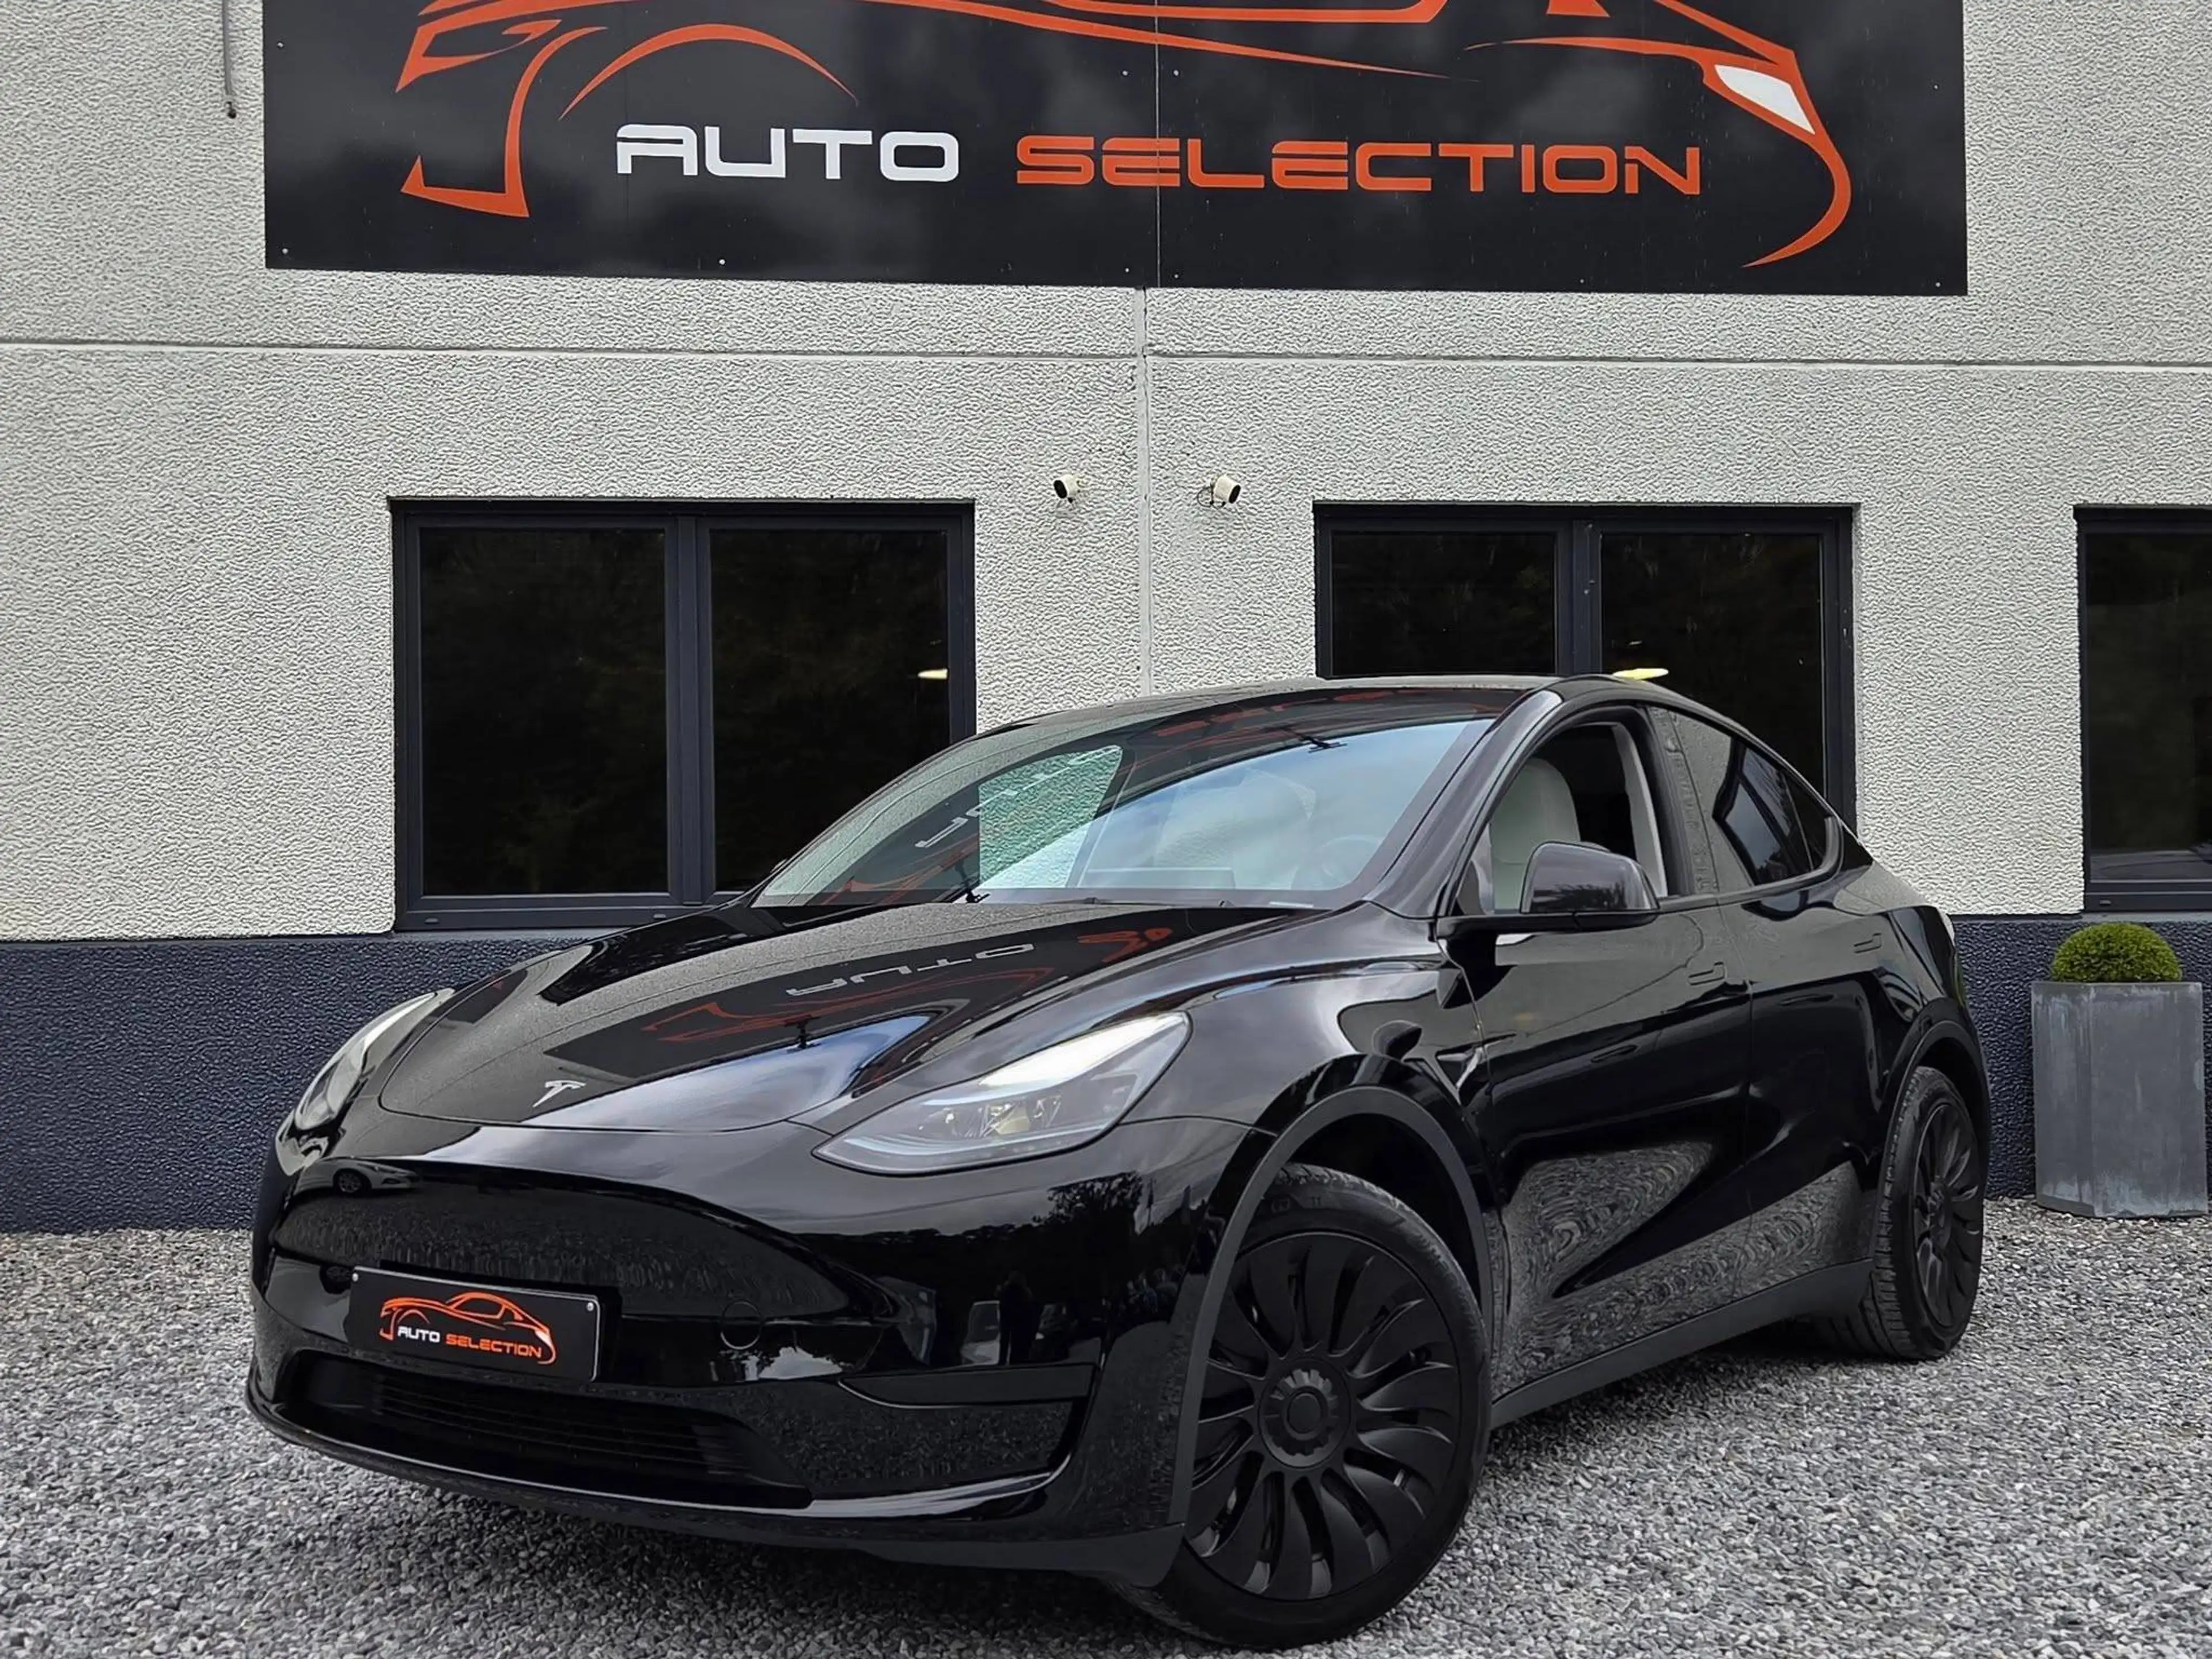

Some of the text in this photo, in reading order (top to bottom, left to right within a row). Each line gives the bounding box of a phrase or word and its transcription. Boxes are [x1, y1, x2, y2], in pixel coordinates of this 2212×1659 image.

[616, 123, 1700, 196] AUTO SELECTION
[397, 1325, 542, 1358] AUTO SELECTION
